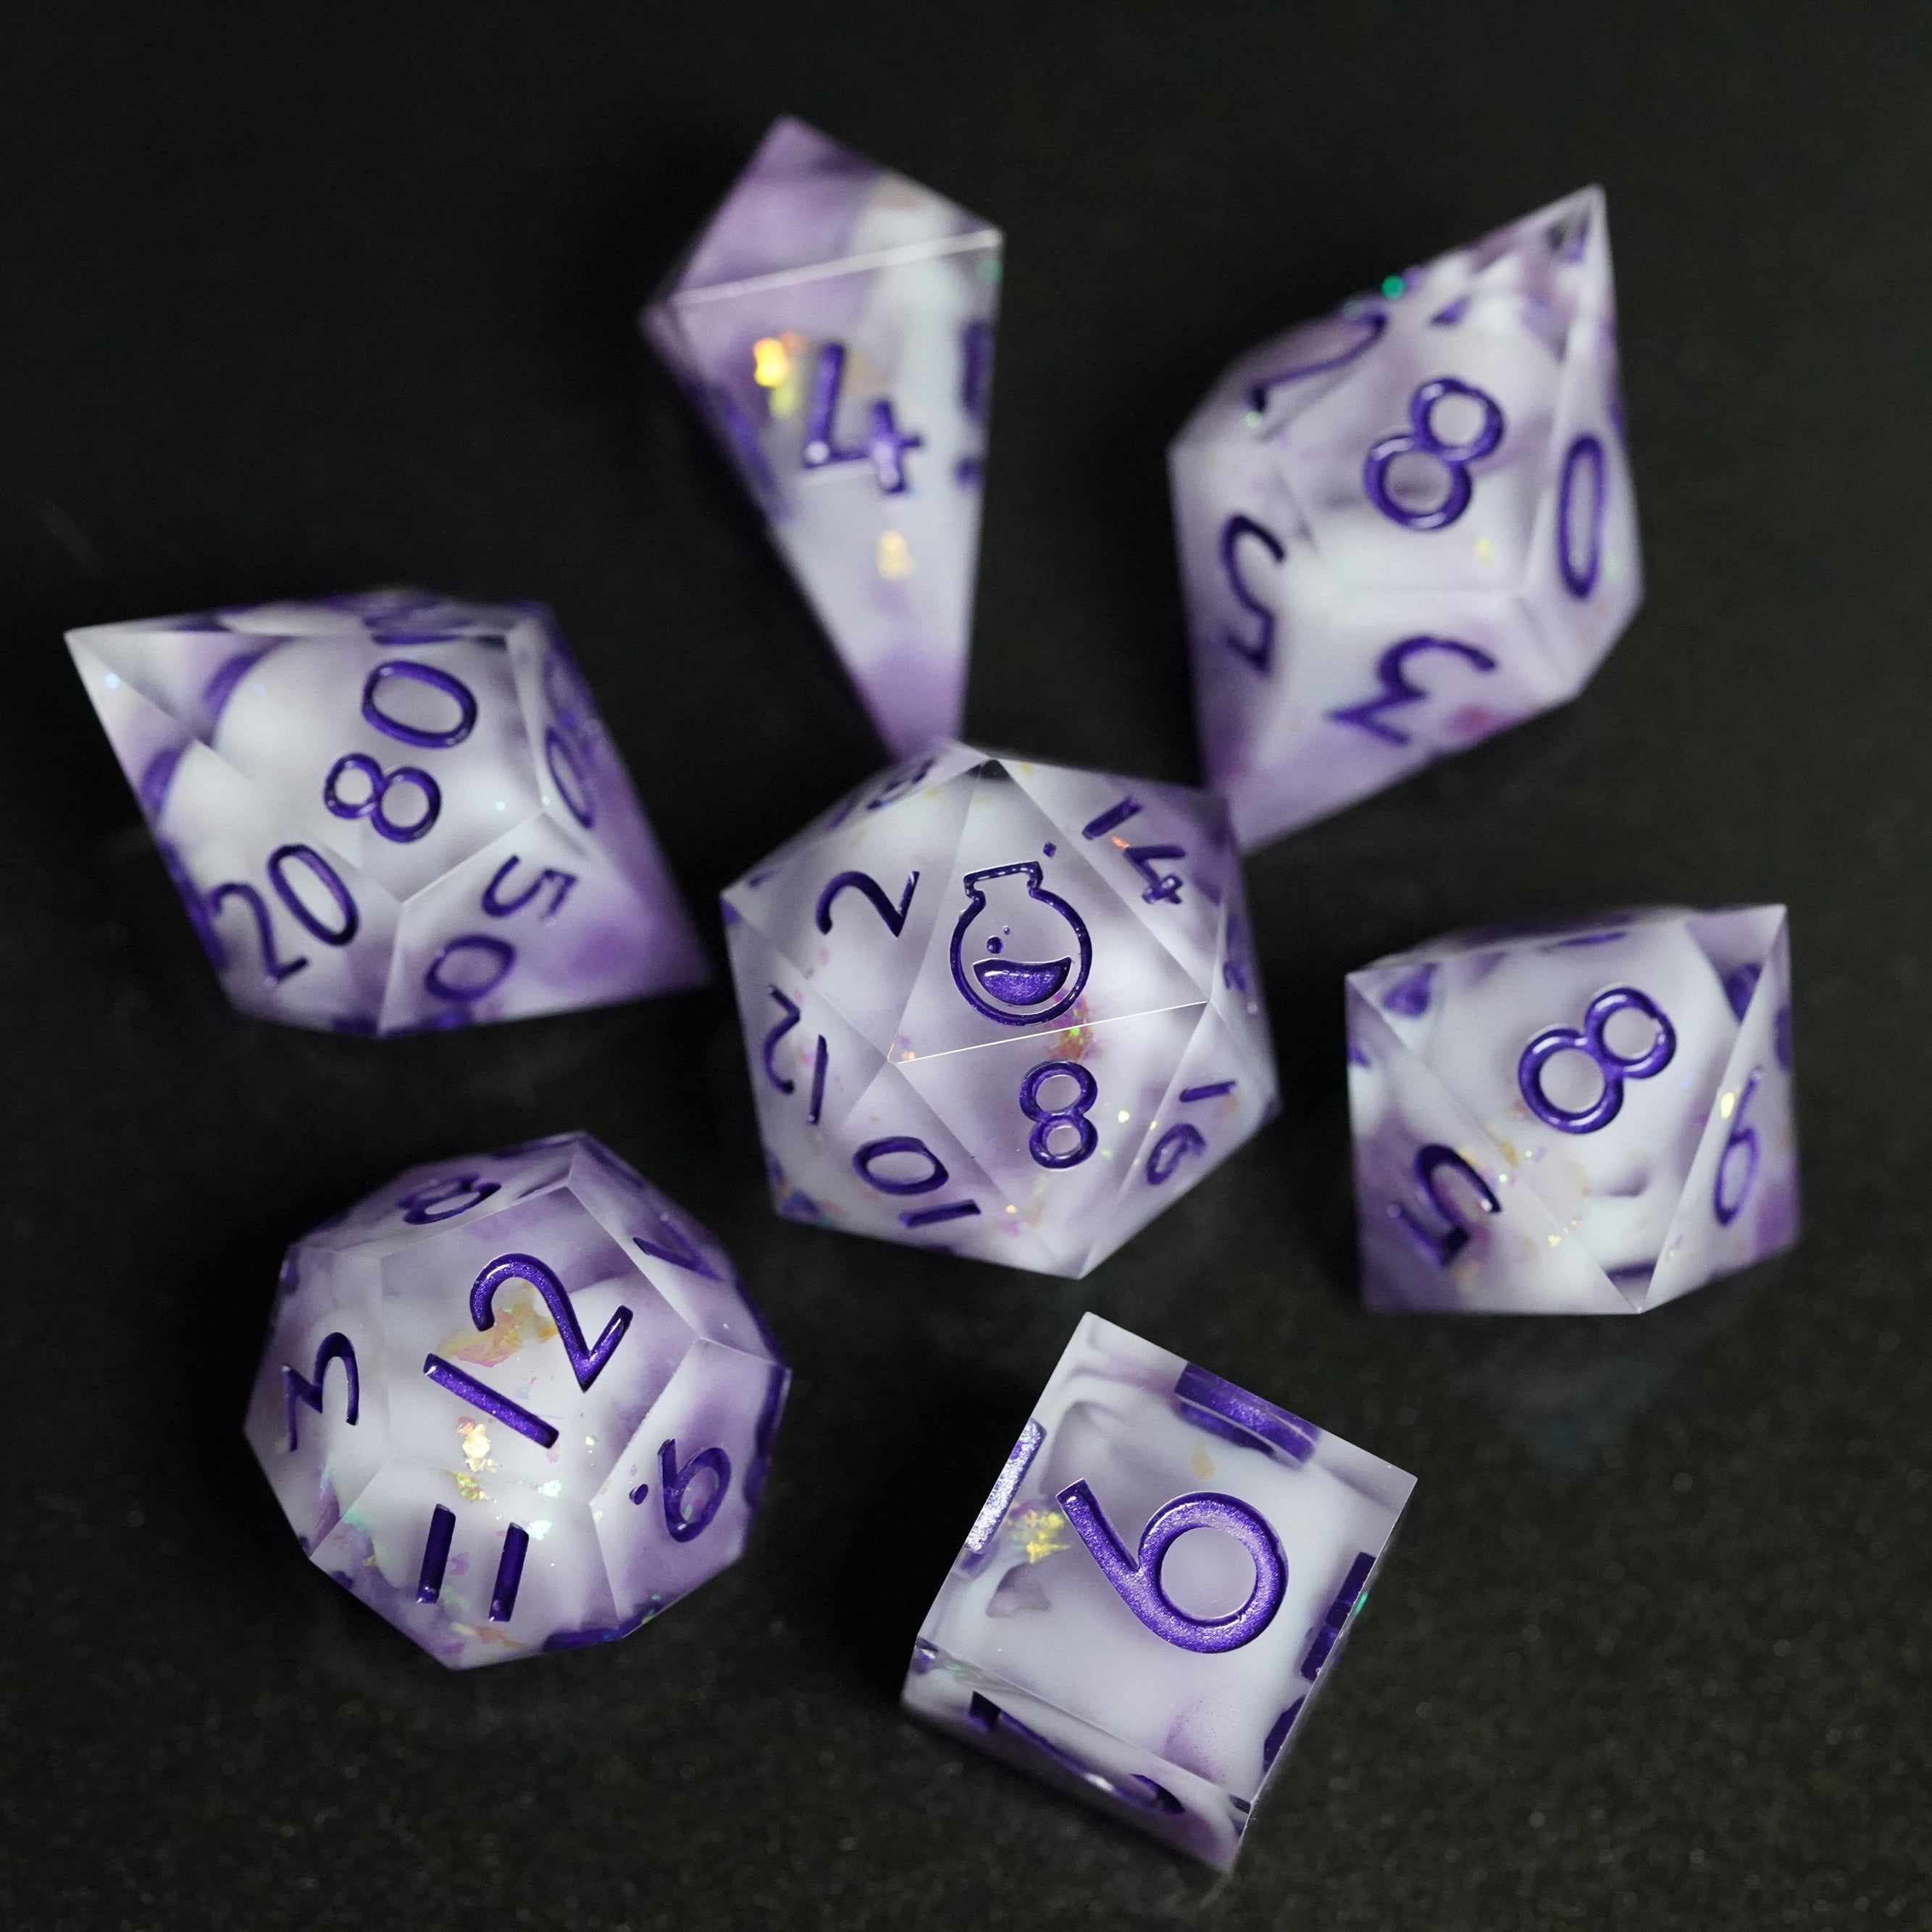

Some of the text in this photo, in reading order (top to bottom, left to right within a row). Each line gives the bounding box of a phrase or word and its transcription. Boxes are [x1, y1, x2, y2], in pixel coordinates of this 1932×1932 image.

[1363, 377, 1505, 532] 8
[1557, 433, 1607, 601] 0
[324, 659, 478, 843] 80
[209, 842, 360, 983] 20
[816, 870, 921, 938] 2
[1019, 1060, 1098, 1170] 8
[1517, 987, 1677, 1135] 8
[852, 1135, 982, 1229] 10
[423, 1252, 635, 1450] 12
[416, 1503, 530, 1623] 11
[1055, 1478, 1289, 1655] 6
